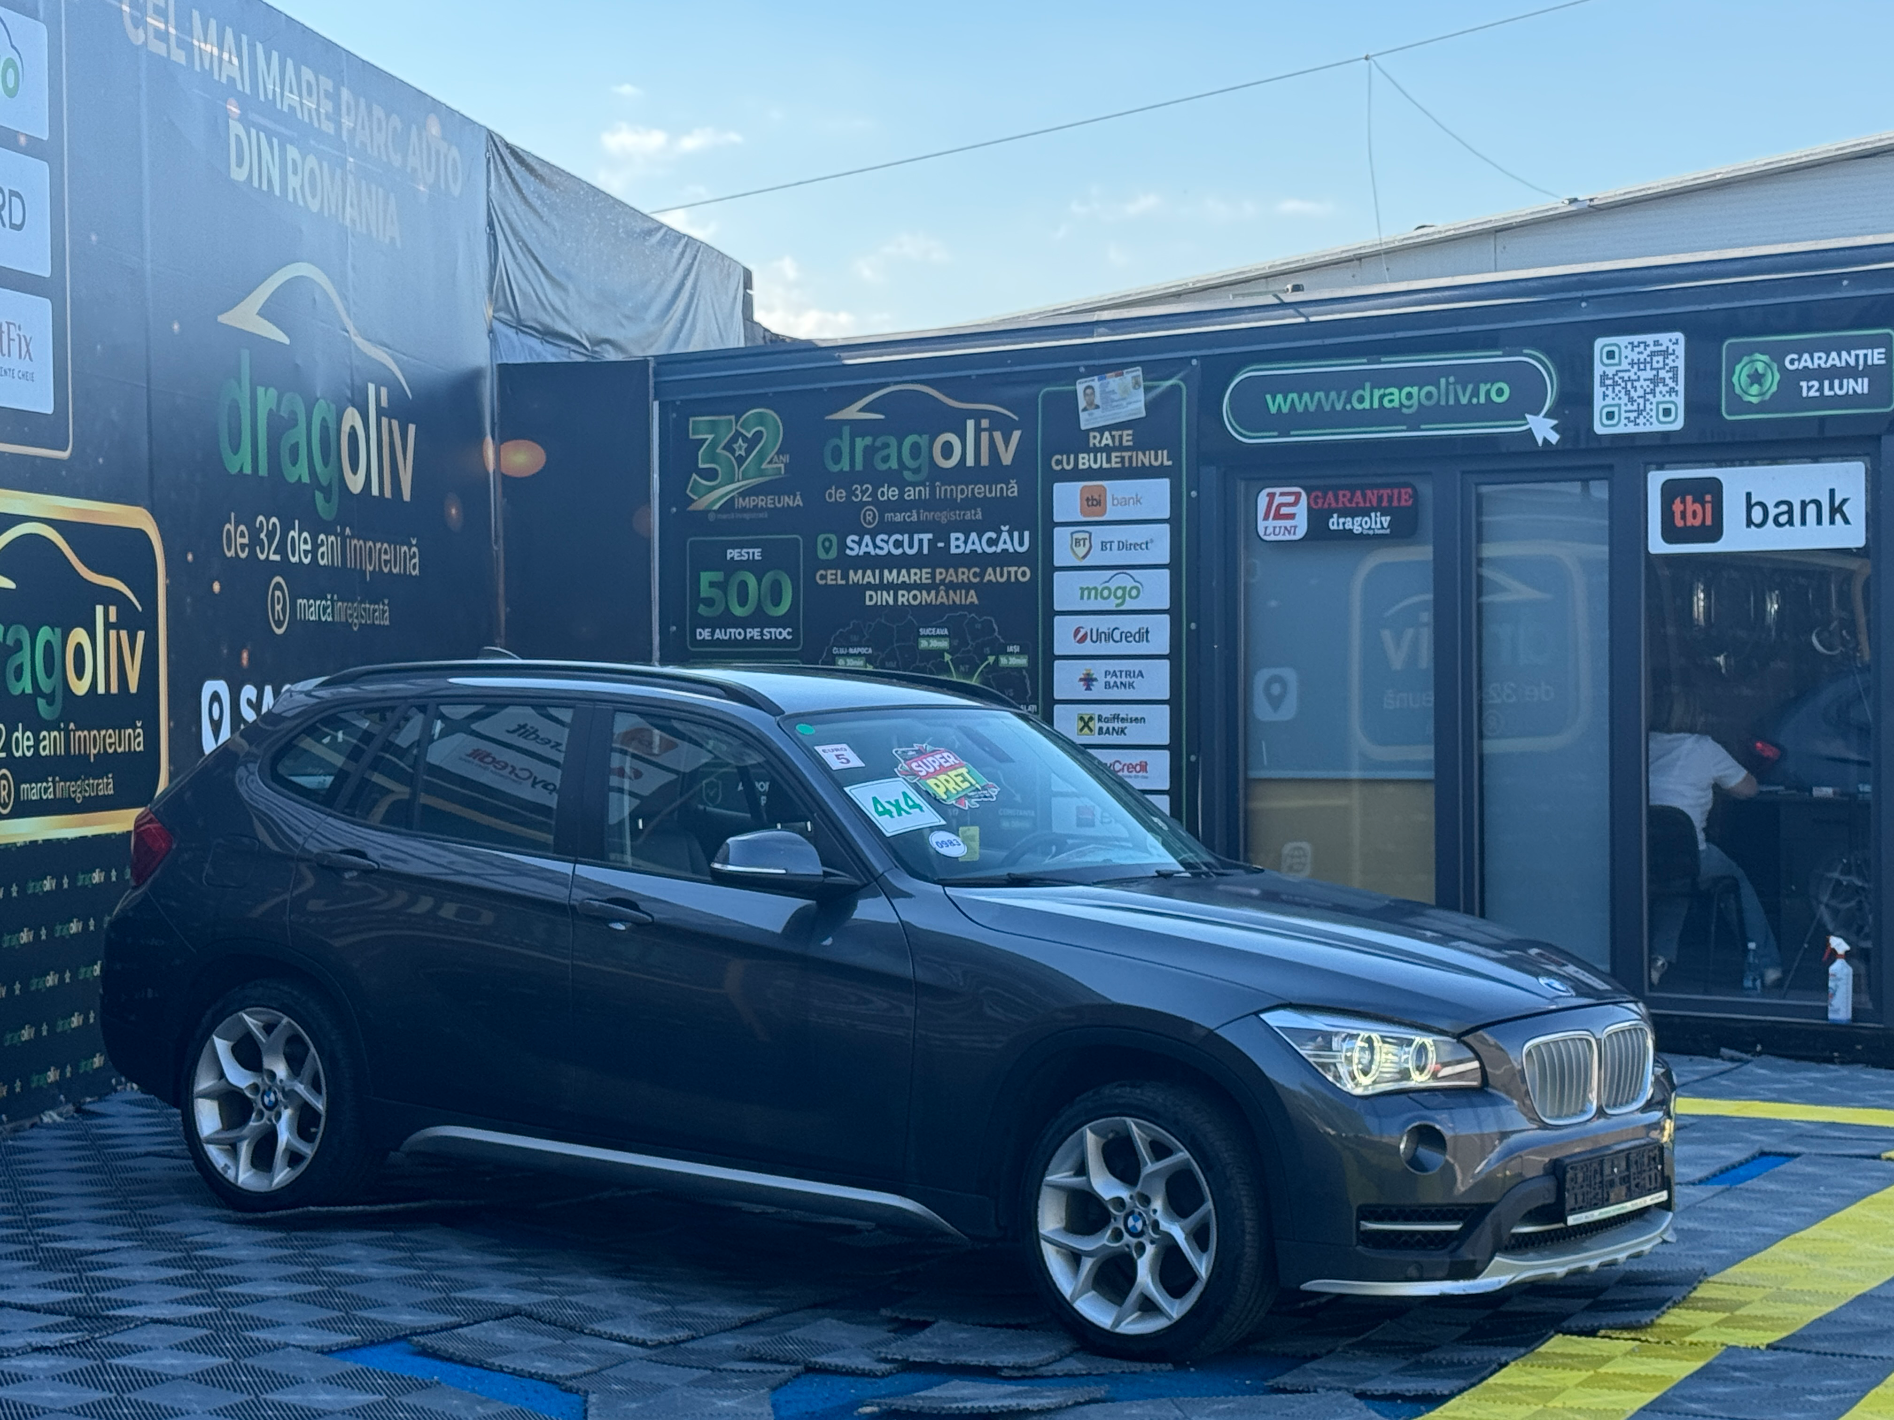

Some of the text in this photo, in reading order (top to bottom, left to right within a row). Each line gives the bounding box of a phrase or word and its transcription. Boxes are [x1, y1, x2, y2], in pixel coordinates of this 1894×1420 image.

[122, 0, 463, 198] CEL MAI MARE PARC AUTO
[229, 118, 400, 249] DIN ROMÂNIA
[1784, 348, 1887, 372] GARANȚIE
[1265, 376, 1510, 415] www.dragoliv.ro
[1799, 377, 1869, 398] 12 LUNI
[218, 348, 416, 521] dragoliv
[1089, 429, 1133, 448] RATE
[686, 408, 784, 501] 32
[823, 418, 1022, 482] dragoliv
[1051, 449, 1172, 470] CU BULETINUL
[734, 492, 803, 509] ÎMPREUNĂ
[825, 479, 1019, 503] de 32 de ani împreună
[1085, 493, 1143, 508] tbi bank
[1309, 488, 1413, 509] GARANTIE
[884, 509, 918, 523] marcă
[919, 508, 983, 524] înregistrată
[1262, 491, 1302, 522] 12
[1672, 488, 1852, 529] tbi bank
[1263, 525, 1298, 537] LUNI
[1328, 511, 1391, 534] dragoliv
[223, 512, 420, 581] de 32 de ani împreună
[845, 533, 933, 556] SASCUT
[949, 525, 1030, 555] BACĂU
[1074, 537, 1150, 552] BT BT Direct
[726, 548, 762, 561] PESTE
[815, 566, 1031, 585] CEL MAI MARE PARC AUTO
[697, 569, 793, 617] 500
[865, 586, 979, 606] DIN ROMÂNIA
[1079, 585, 1141, 608] mogo
[297, 594, 333, 622] marcă
[333, 595, 390, 632] înregistrată
[696, 628, 793, 640] DE AUTO PE STOC
[1090, 626, 1150, 644] UniCredit
[0, 605, 145, 721] agoliv
[1104, 669, 1145, 680] PATRIA
[1104, 680, 1136, 690] BANK
[1097, 714, 1146, 725] Raiffeisen
[12, 722, 34, 758] de
[39, 723, 65, 757] ani
[70, 720, 144, 763] împreună
[1097, 727, 1128, 737] BANK
[835, 753, 850, 765] 5
[911, 752, 960, 777] SUPER
[20, 776, 54, 801] marcă
[55, 773, 114, 804] înregistrată
[871, 791, 925, 819] 4x4
[935, 839, 961, 850] 0983
